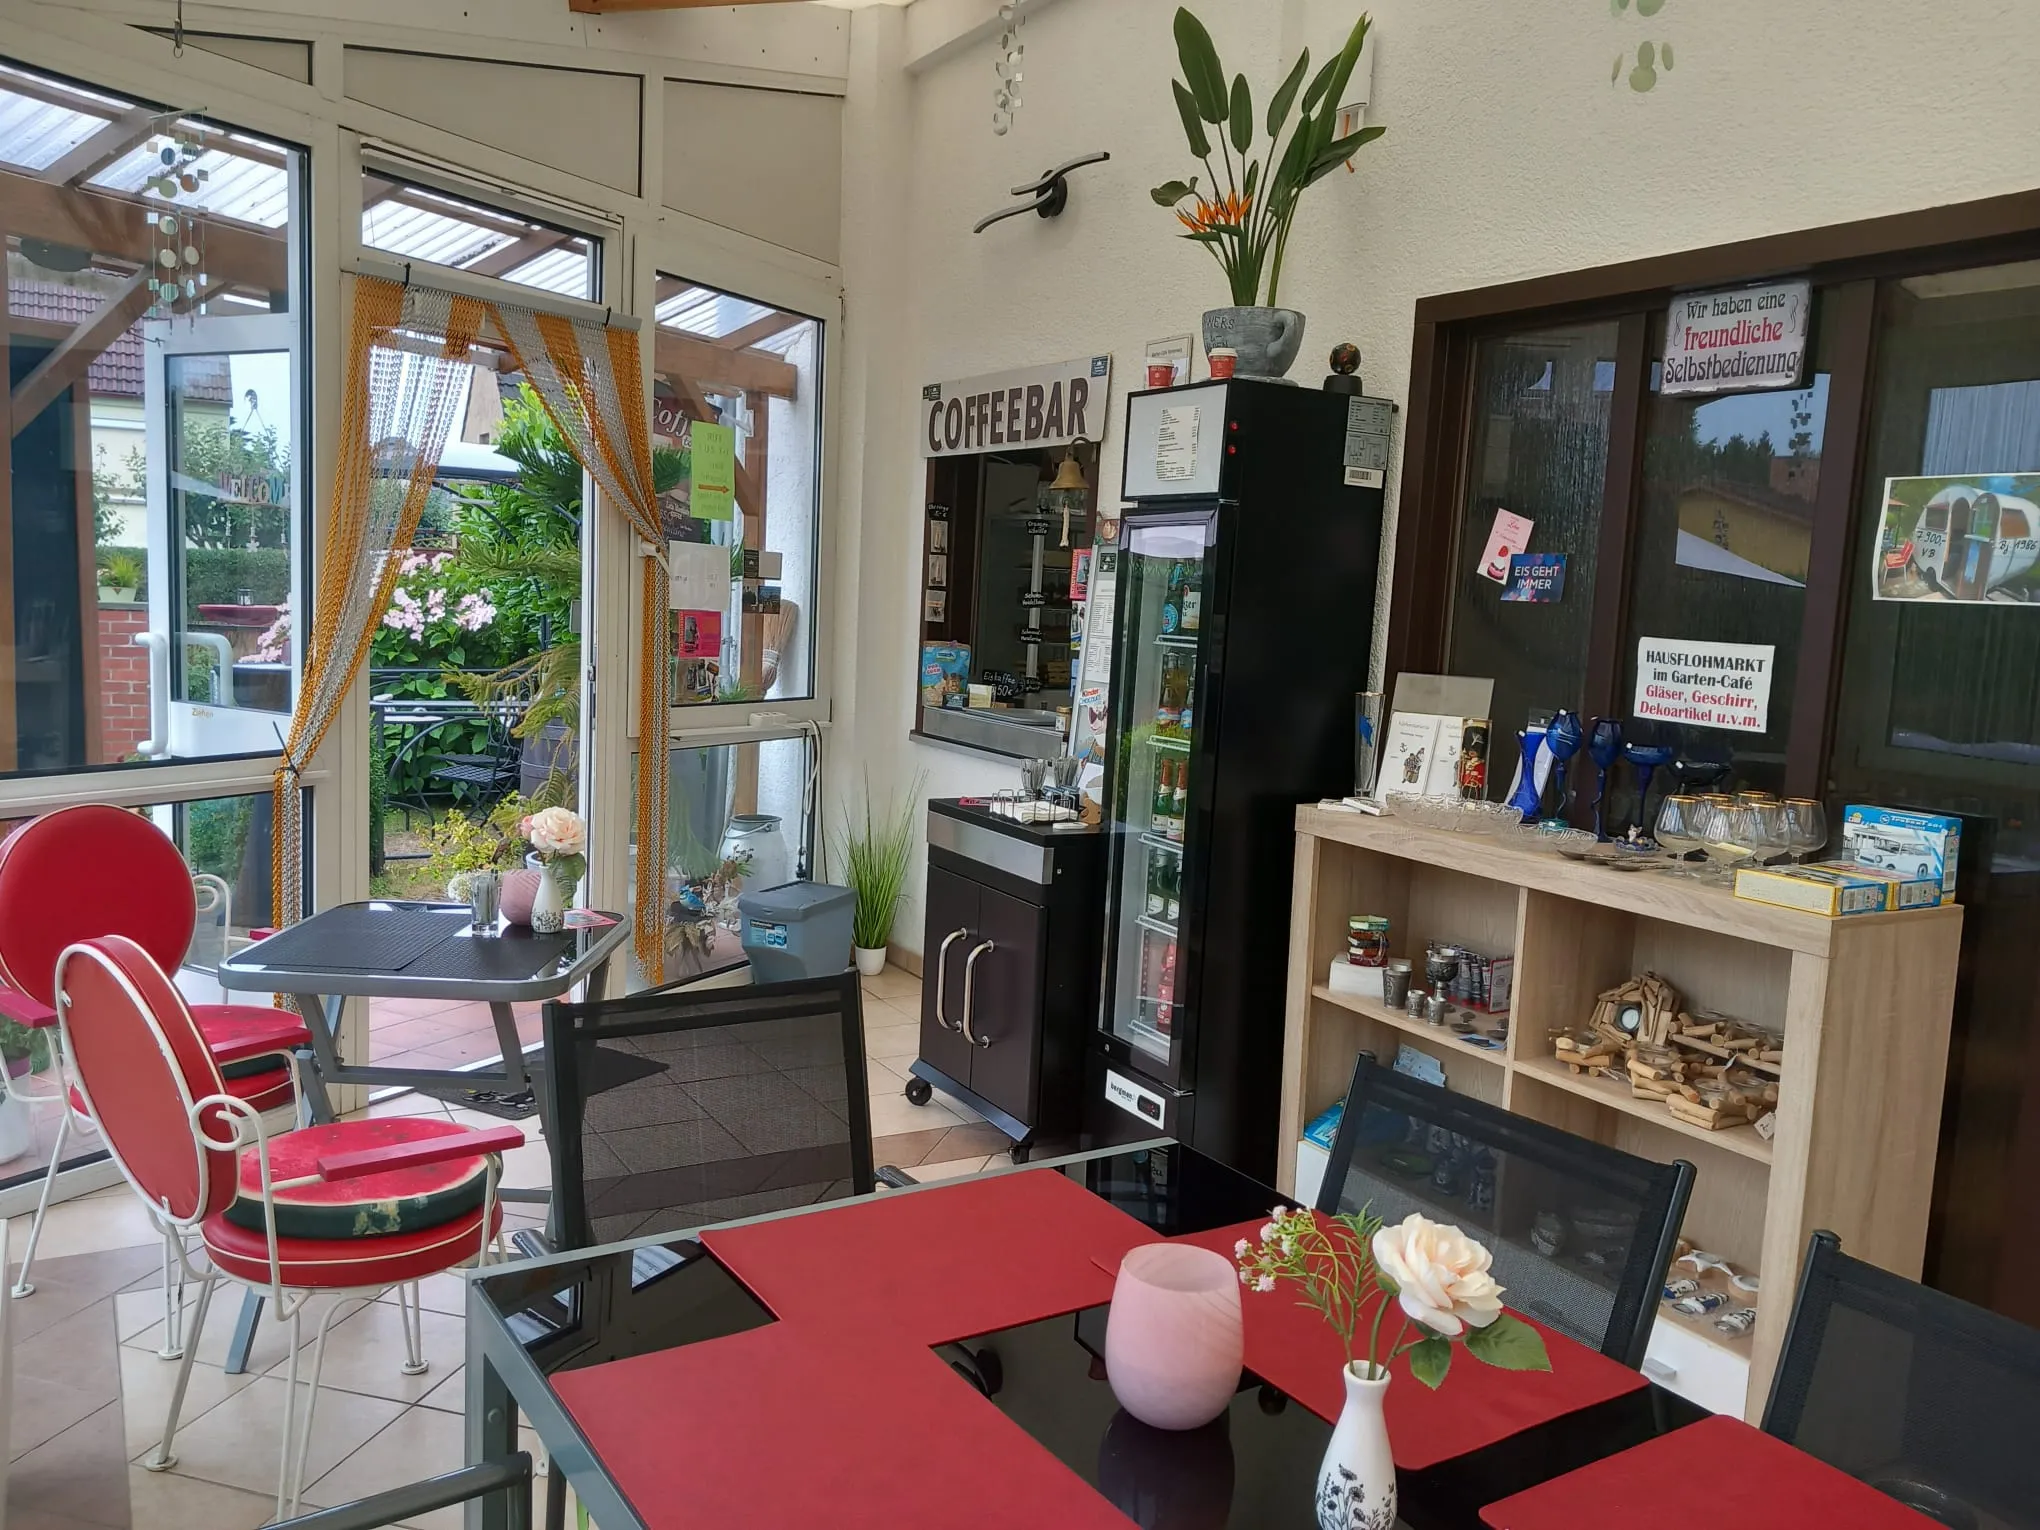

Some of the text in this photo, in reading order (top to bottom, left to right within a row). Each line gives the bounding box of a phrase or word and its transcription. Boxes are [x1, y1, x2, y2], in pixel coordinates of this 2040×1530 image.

[1687, 291, 1786, 320] Wir haben eine
[1684, 317, 1783, 351] freundliche
[1665, 351, 1798, 383] Selbstbedienung
[928, 377, 1089, 452] COFFEEBAR
[2014, 540, 2039, 550] 1986
[1514, 566, 1560, 577] EIS GEHT
[1516, 579, 1552, 590] IMMER
[1646, 650, 1766, 673] HAUSFLOHMARKT
[1653, 668, 1753, 690] im Garten-Café
[1646, 684, 1758, 711] Gläser, Geschirr,
[1640, 701, 1761, 728] Dekoartikel u.v.m.
